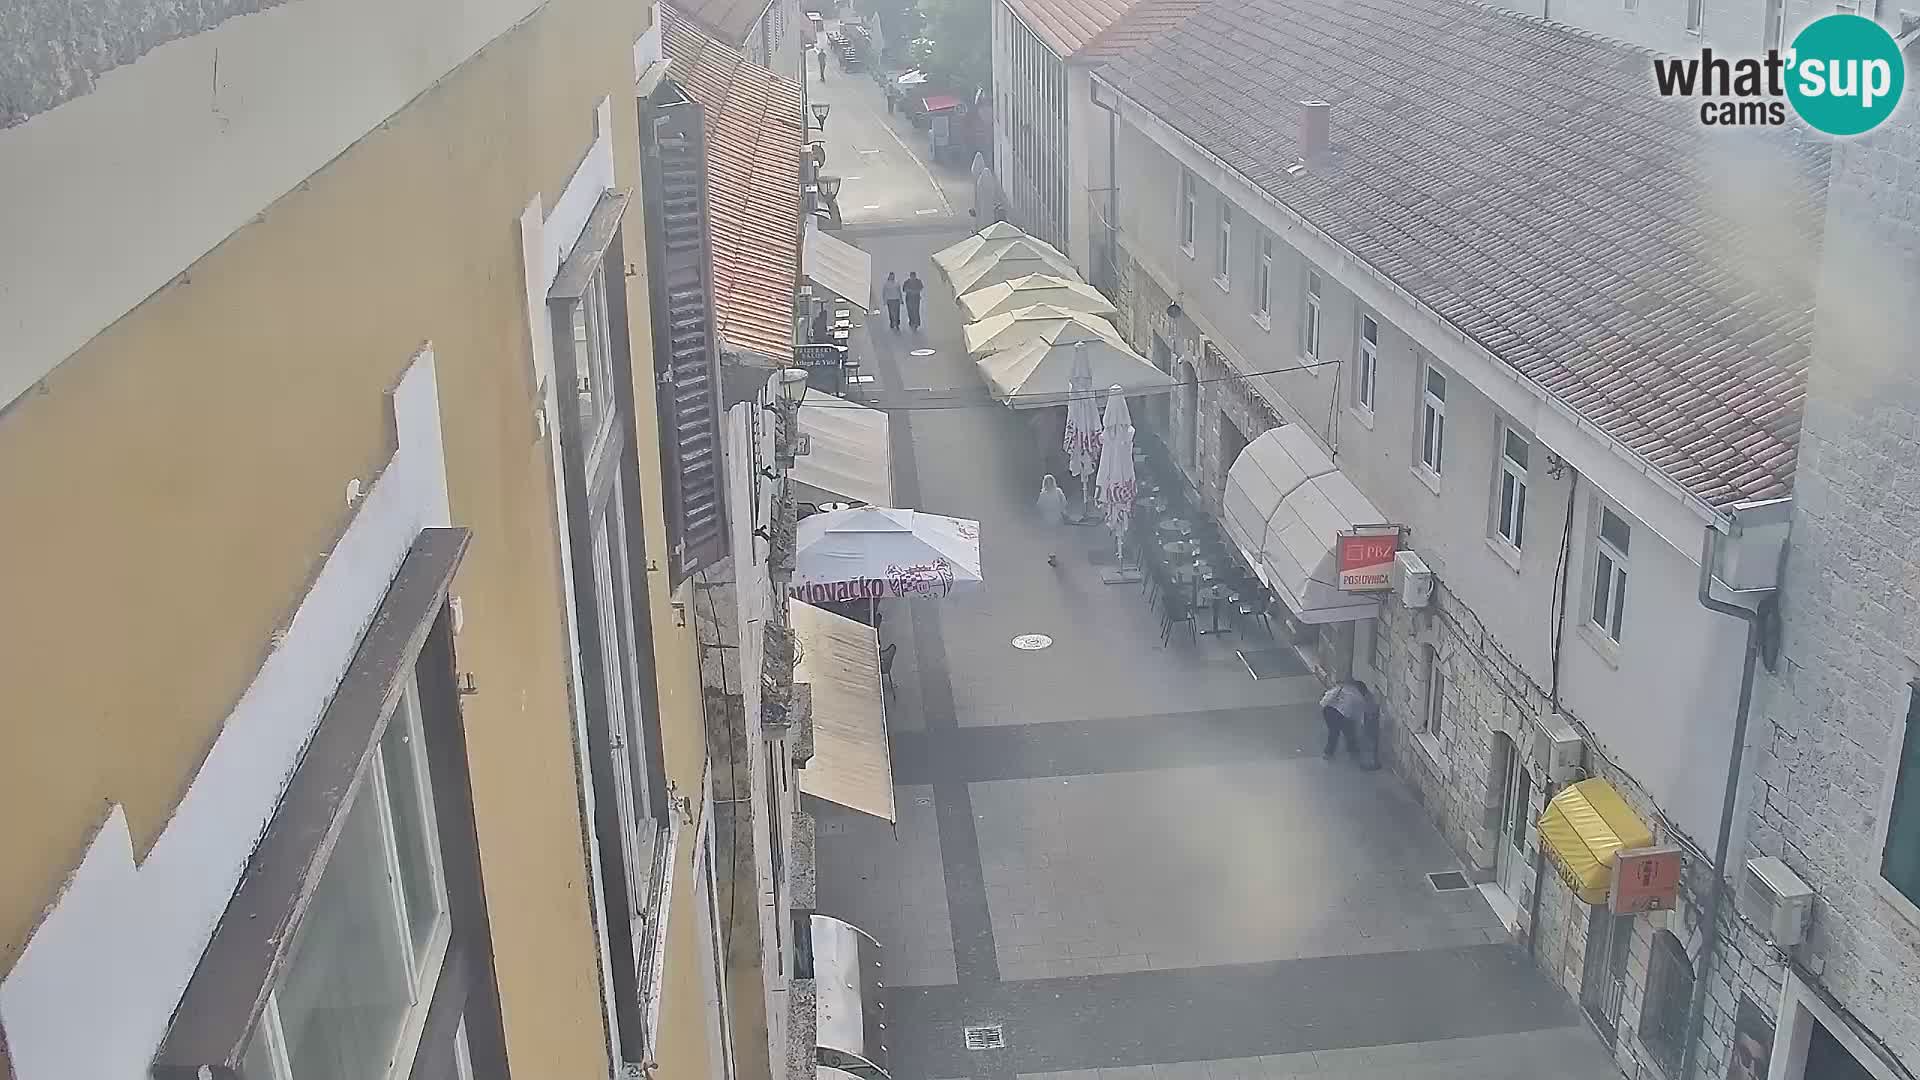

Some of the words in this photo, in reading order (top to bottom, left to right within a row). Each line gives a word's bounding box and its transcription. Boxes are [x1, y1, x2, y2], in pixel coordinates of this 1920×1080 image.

[1367, 544, 1392, 560] PBZ
[1343, 574, 1389, 585] POSLOVNICA
[789, 577, 884, 602] arlovačko
